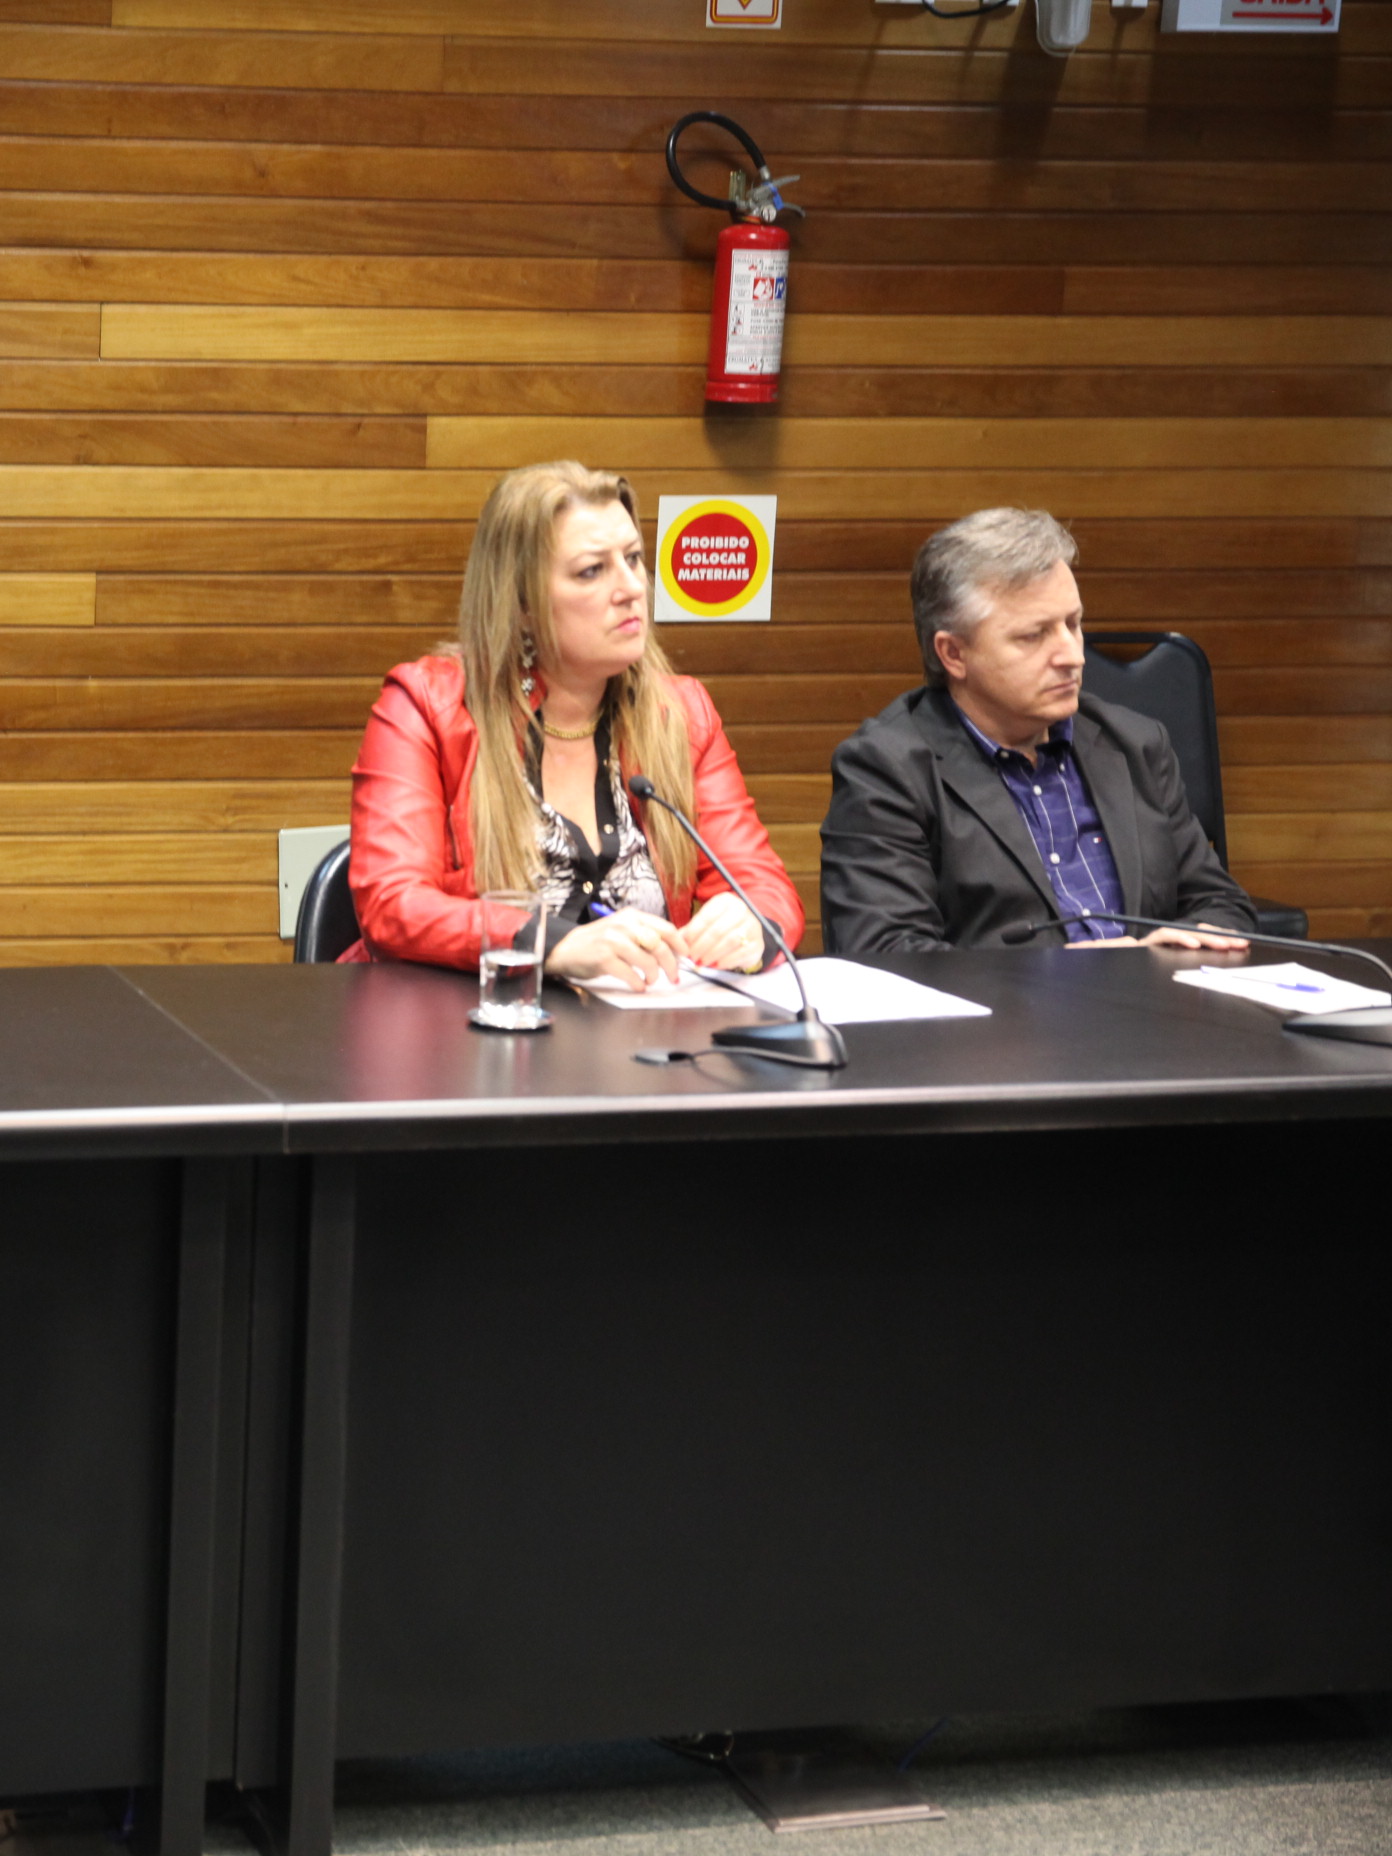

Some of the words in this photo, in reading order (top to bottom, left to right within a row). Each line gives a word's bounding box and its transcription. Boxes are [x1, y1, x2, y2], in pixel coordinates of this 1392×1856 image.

[681, 536, 750, 549] PROIBIDO
[683, 552, 746, 565] COLOCAR
[677, 568, 750, 581] MATERIAIS
